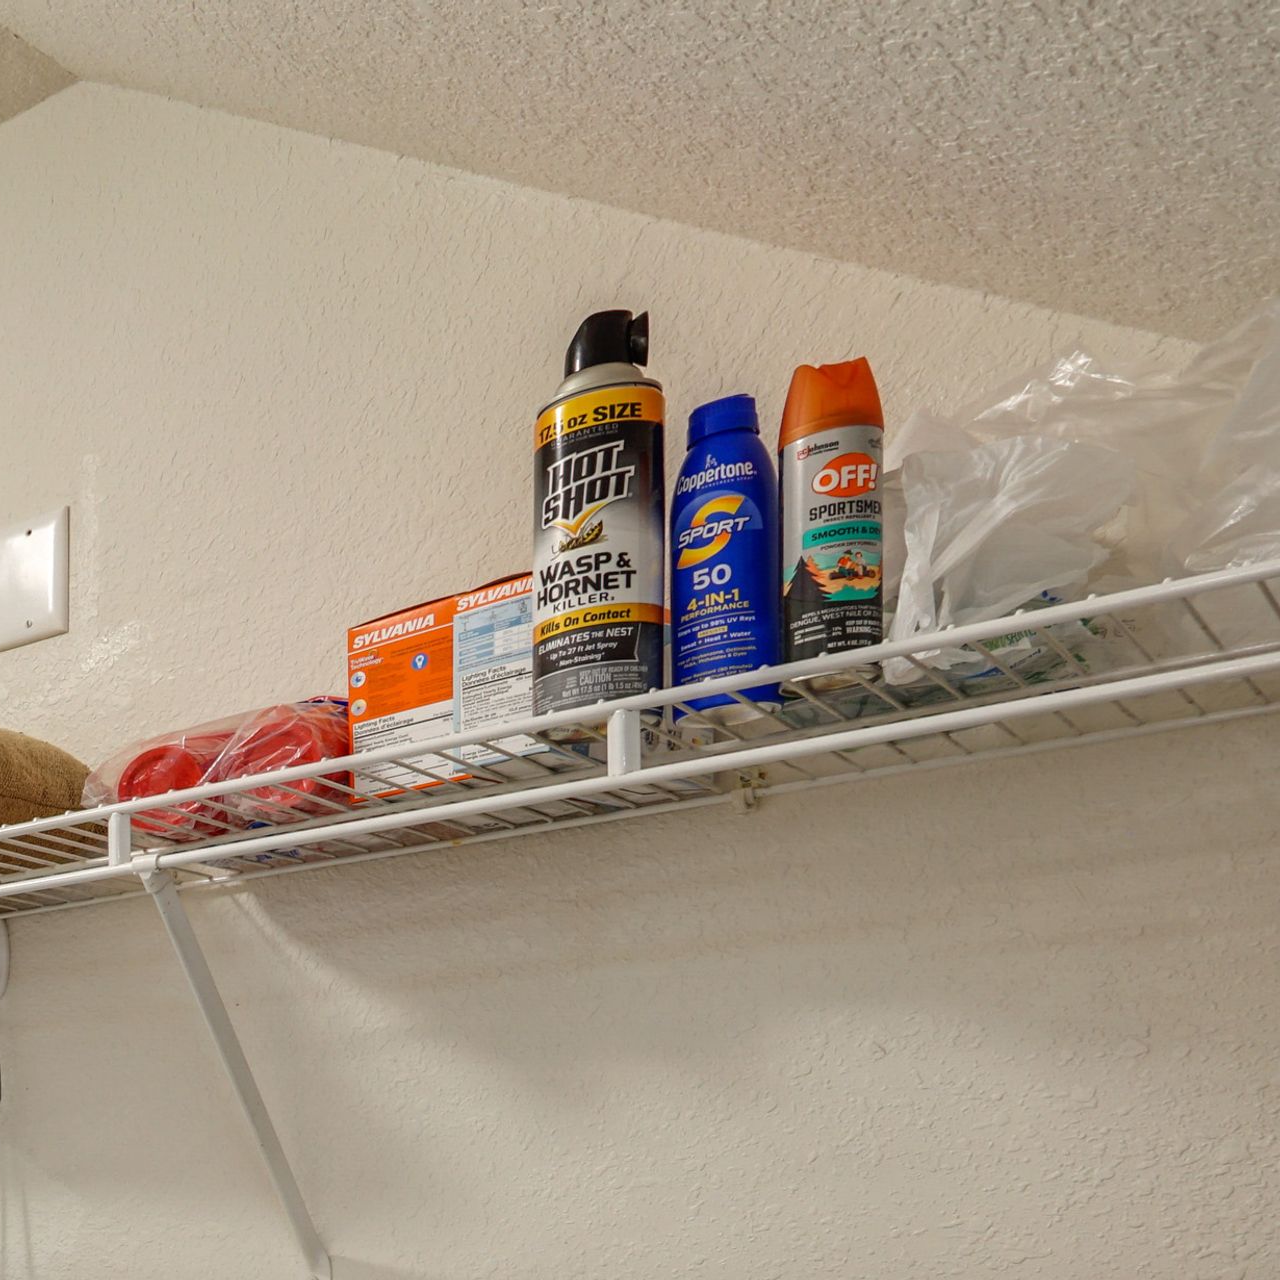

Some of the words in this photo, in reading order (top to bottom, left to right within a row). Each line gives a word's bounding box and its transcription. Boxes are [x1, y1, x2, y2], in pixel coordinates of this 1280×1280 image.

[539, 419, 563, 443] 17.5
[567, 414, 587, 429] oz
[593, 402, 642, 422] SIZE
[547, 440, 625, 497] HOT
[677, 462, 754, 495] Coppertone
[812, 464, 878, 493] OFF!
[542, 465, 635, 529] SHOT
[678, 517, 750, 548] SPORT
[811, 527, 859, 541] SMOOTH
[862, 526, 867, 534] &
[540, 552, 612, 587] WASP
[616, 552, 631, 568] &
[693, 564, 732, 590] 50
[537, 570, 636, 610] HORNET
[553, 592, 612, 613] KILLER
[687, 589, 739, 610] 4-IN-1
[540, 621, 560, 636] Kills
[564, 616, 579, 628] On
[583, 608, 631, 622] Contact
[681, 601, 749, 622] PERFORMANCE
[822, 612, 844, 621] WEST
[353, 613, 435, 649] SYLVANIA
[539, 631, 590, 655] ELIMINATES
[606, 627, 633, 637] NEST
[705, 635, 721, 643] Heat
[550, 652, 558, 661] Up
[597, 641, 618, 650] Spray
[462, 671, 486, 682] Lighting
[488, 665, 506, 674] Facts
[580, 673, 612, 685] CAUTION
[355, 720, 378, 730] Lighting
[379, 716, 395, 724] Facts
